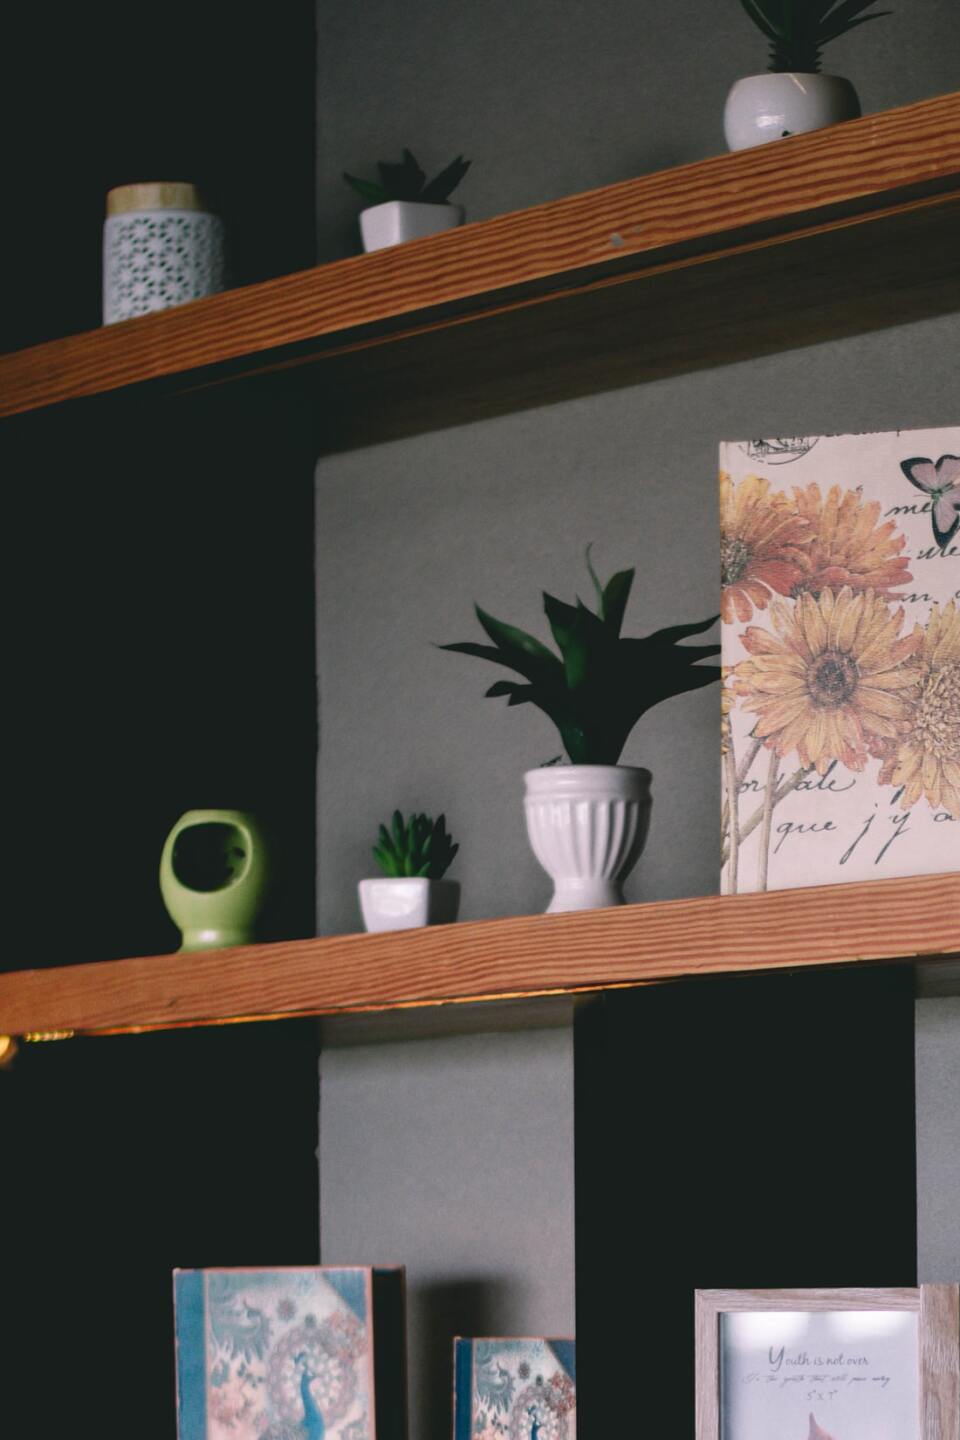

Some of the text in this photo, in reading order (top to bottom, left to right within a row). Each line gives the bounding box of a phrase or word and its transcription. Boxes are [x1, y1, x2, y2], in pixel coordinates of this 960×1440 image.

[768, 1346, 869, 1372] Youth is not over
